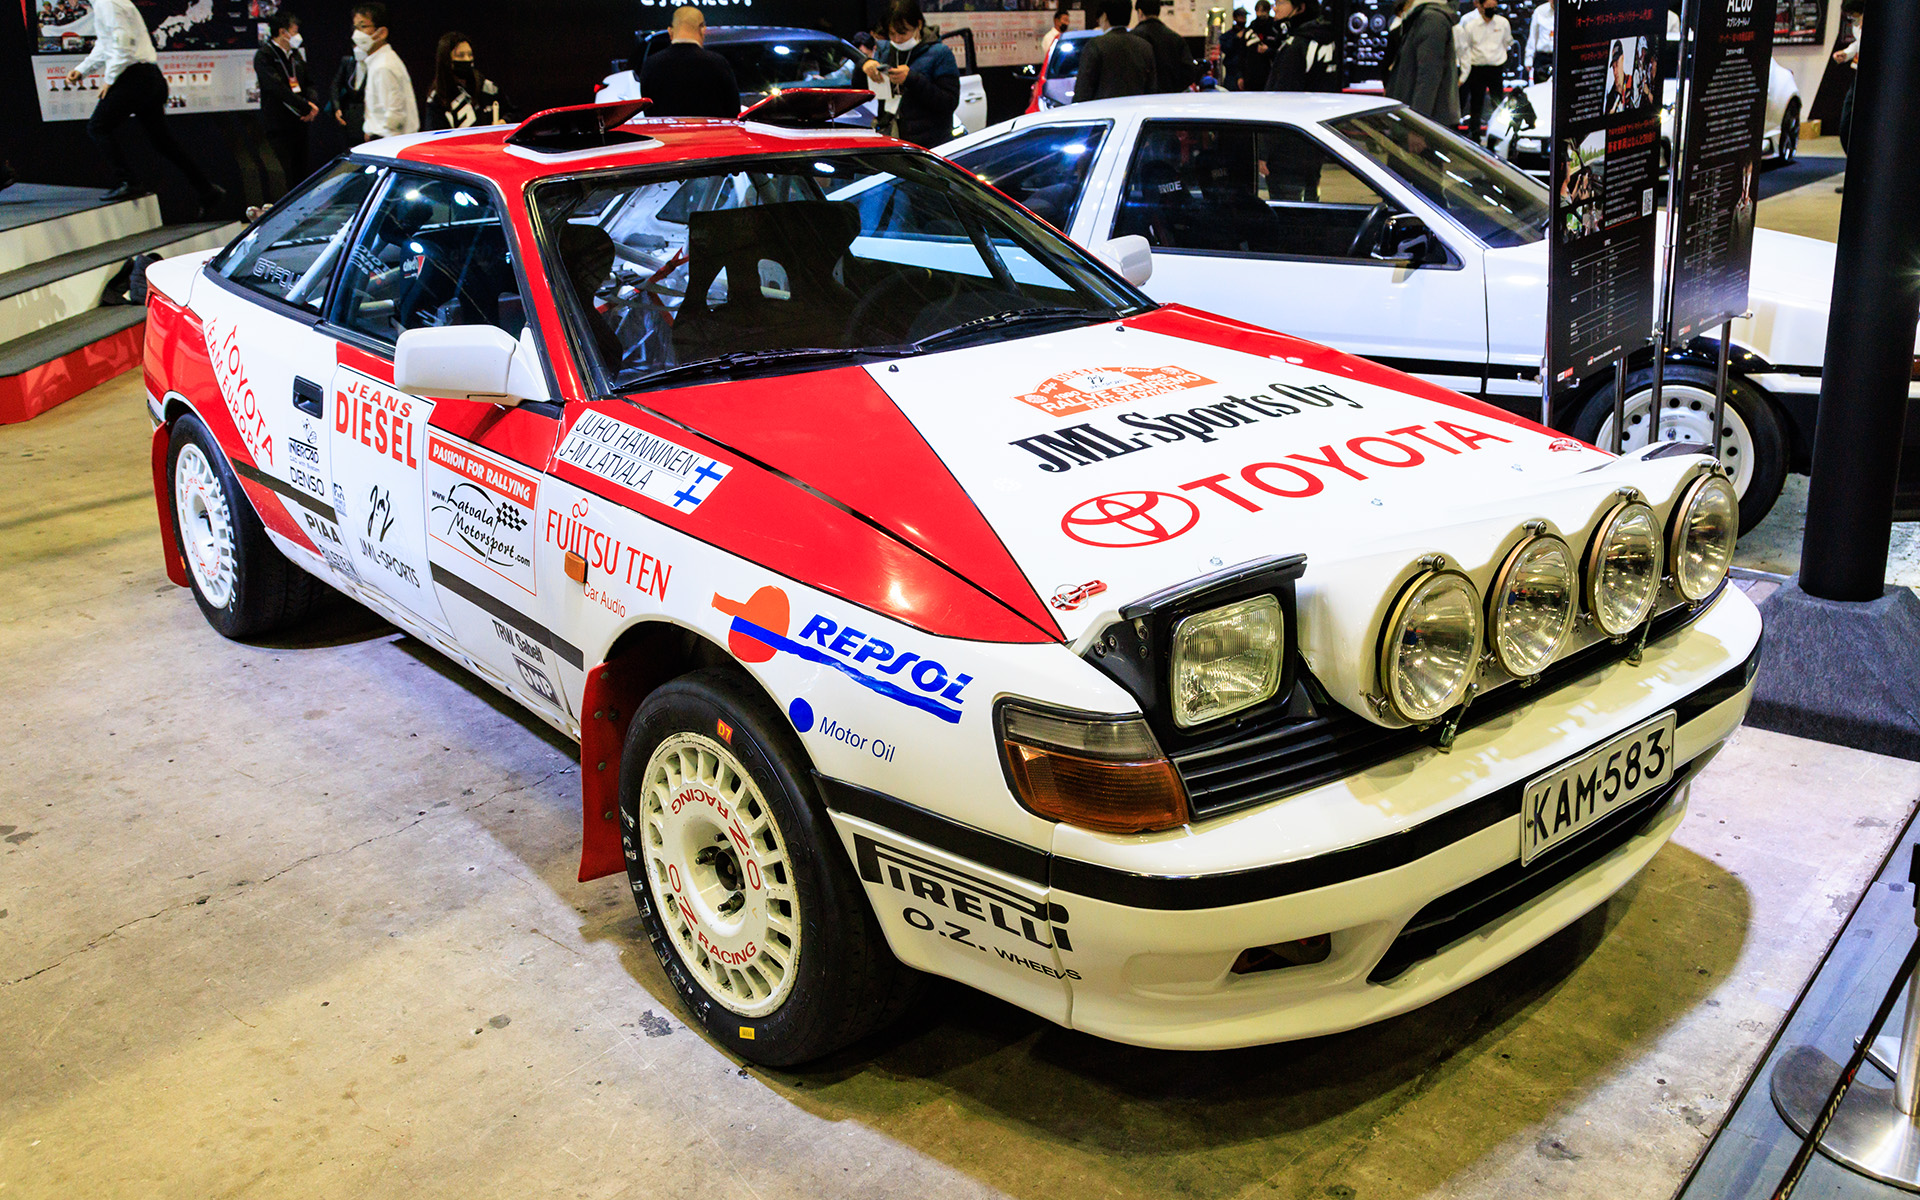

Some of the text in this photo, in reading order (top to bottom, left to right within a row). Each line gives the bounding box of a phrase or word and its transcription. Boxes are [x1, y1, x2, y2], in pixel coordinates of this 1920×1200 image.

[205, 317, 223, 375] TEAM
[222, 375, 260, 461] EUROPE
[223, 325, 274, 467] TOYOTA
[348, 380, 413, 418] JEANS
[1041, 389, 1114, 412] RALLYE
[1112, 373, 1202, 395] SANREMO
[335, 390, 418, 470] DIESEL
[576, 413, 700, 476] JUHO HÄNNINEN
[1008, 381, 1364, 473] JML-Sports Oy
[289, 465, 325, 497] DENSO
[432, 442, 532, 502] PASSION FOR RALLYING
[559, 438, 654, 490] J-M LATVALA
[1178, 412, 1512, 513] TOYOTA
[304, 512, 342, 546] PIAA
[546, 508, 673, 602] FUJITSU TEN
[359, 537, 421, 589] JML-SPORTS
[583, 581, 627, 618] Car Audio
[491, 618, 546, 665] TRW Sabelt
[798, 613, 974, 705] REPSOL
[718, 721, 733, 741] D7
[819, 716, 896, 763] Motor Oil
[671, 787, 729, 819] RACING
[1533, 727, 1666, 848] KAM-583
[853, 832, 1074, 952] PIRELLI
[698, 930, 758, 966] RACING
[994, 945, 1083, 980] WHEELS
